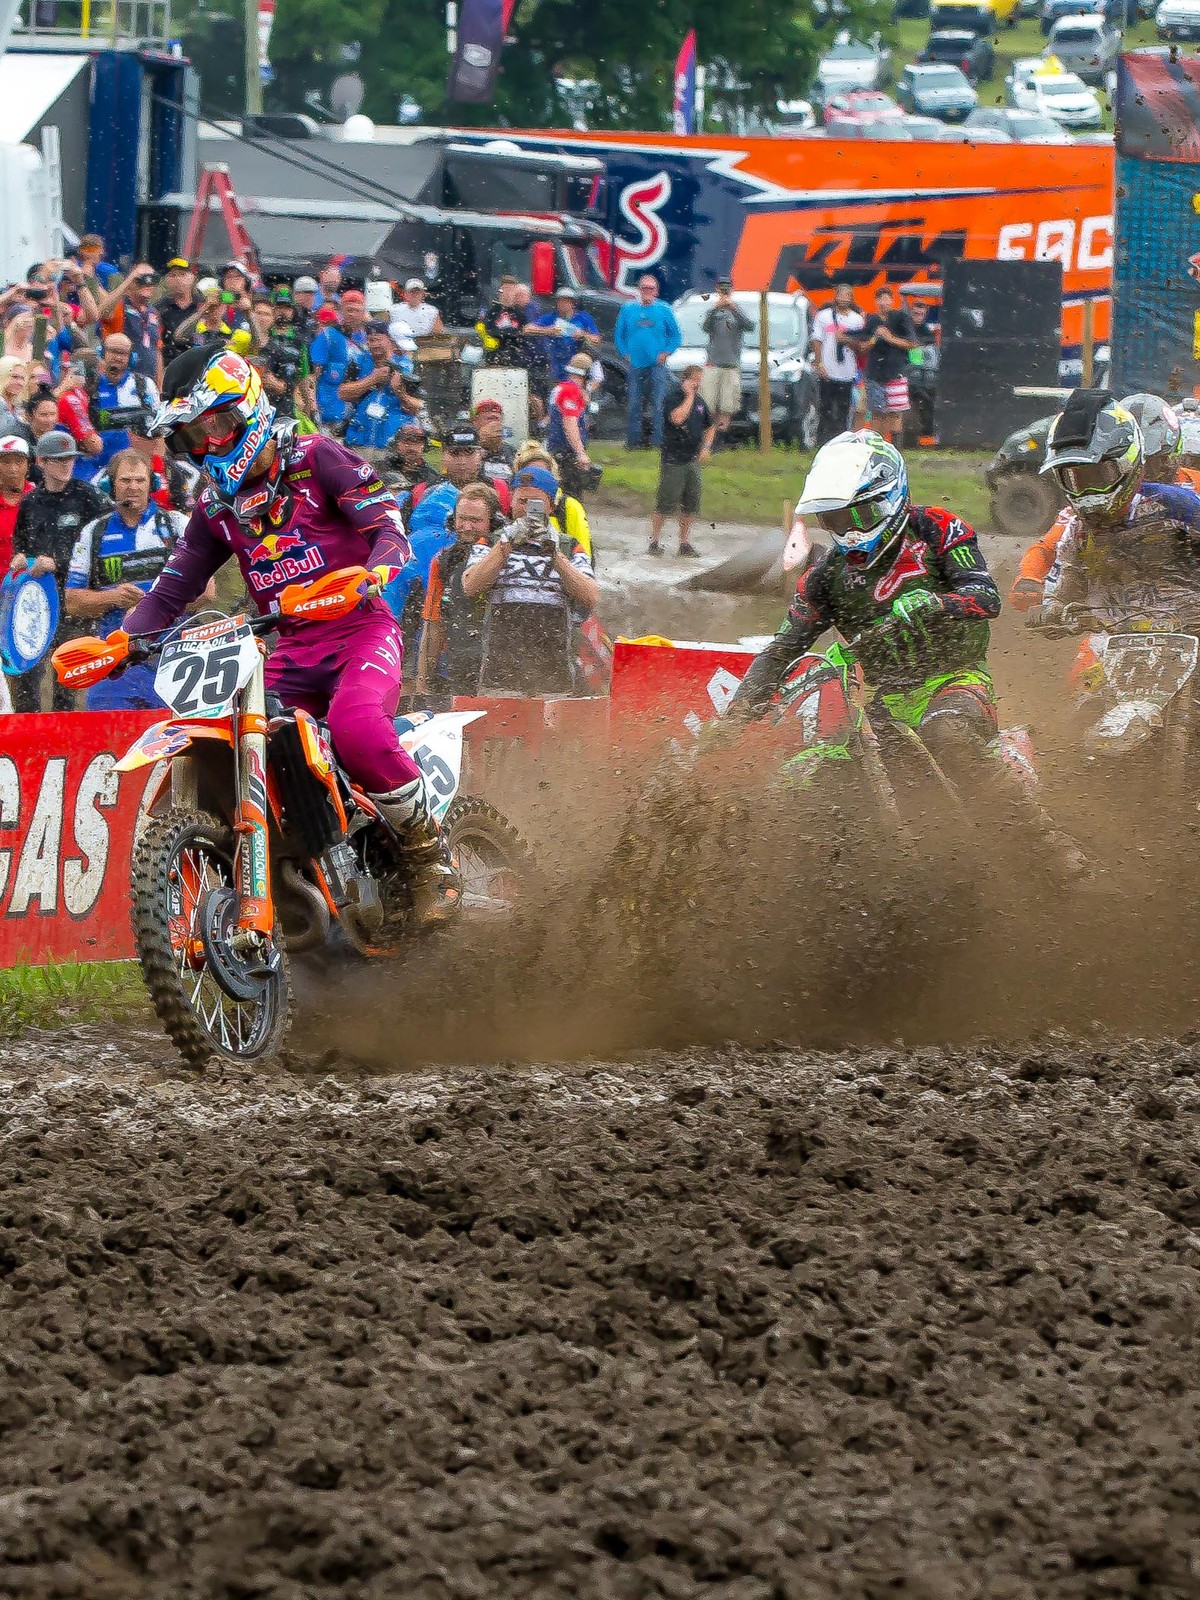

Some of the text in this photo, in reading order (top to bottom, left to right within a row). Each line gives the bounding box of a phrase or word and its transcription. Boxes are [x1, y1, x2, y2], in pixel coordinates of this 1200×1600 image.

[771, 217, 967, 293] KTM
[227, 409, 268, 482] Red Bull
[240, 491, 269, 514] KTM
[249, 545, 325, 592] Red Bull
[293, 594, 346, 613] ACERBIS
[185, 618, 240, 640] RENTHAL
[211, 635, 228, 649] OIL
[64, 655, 115, 680] ACERBIS
[171, 645, 243, 714] 25
